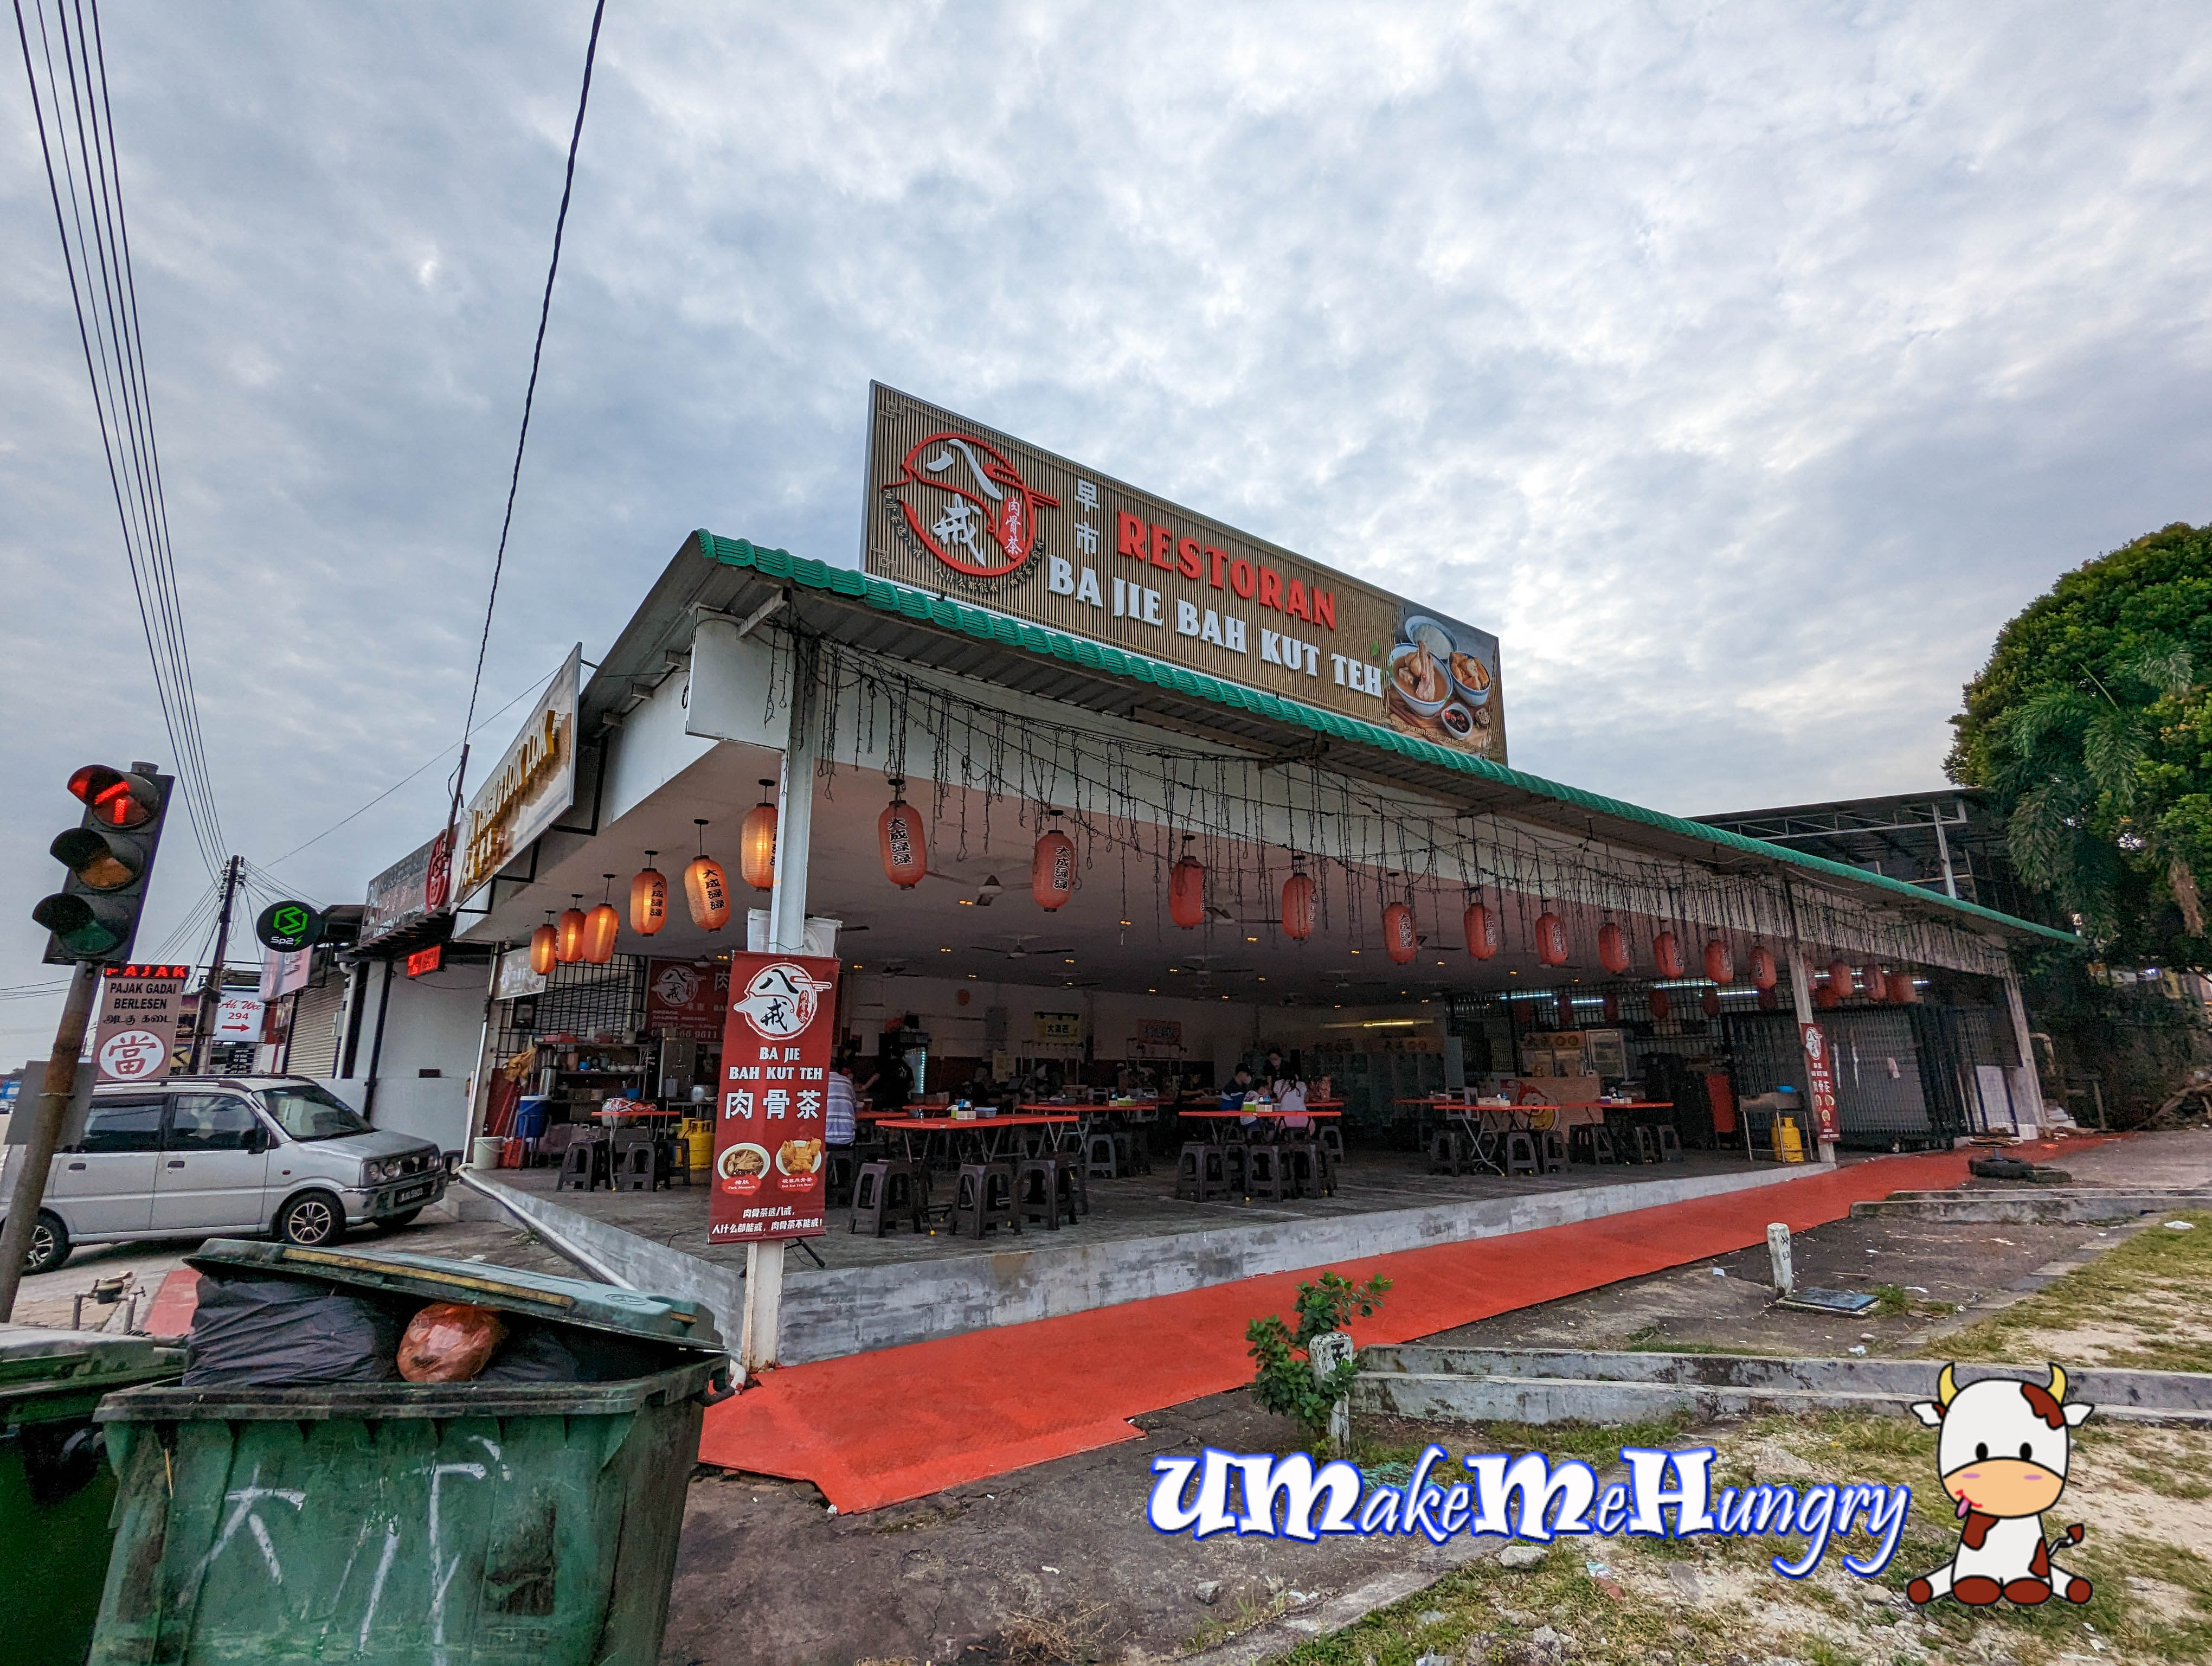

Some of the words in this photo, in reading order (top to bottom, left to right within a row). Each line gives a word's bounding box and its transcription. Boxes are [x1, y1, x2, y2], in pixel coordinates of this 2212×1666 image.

[1004, 496, 1024, 555] 肉骨茶
[1117, 510, 1336, 631] RESTORAN
[1047, 554, 1104, 608] BA
[1113, 576, 1163, 627] JIE
[1176, 598, 1247, 654] BAH
[1261, 628, 1320, 677] KUT
[1330, 652, 1383, 699] TEH
[110, 983, 142, 994] PAJAK
[146, 983, 177, 995] GADAI
[114, 998, 166, 1010] BERLESEN
[219, 998, 237, 1009] Ah
[241, 1000, 262, 1010] Wee
[799, 990, 808, 1023] 肉骨茶
[102, 1015, 136, 1026] அடகு
[141, 1015, 172, 1023] கடை
[228, 1012, 249, 1020] 294
[108, 1034, 157, 1075] 當
[759, 1047, 779, 1061] BA
[783, 1047, 801, 1062] JIE
[729, 1066, 760, 1080] BAH
[766, 1066, 795, 1080] KUT
[799, 1066, 822, 1081] TEH
[725, 1088, 821, 1120] 肉骨茶
